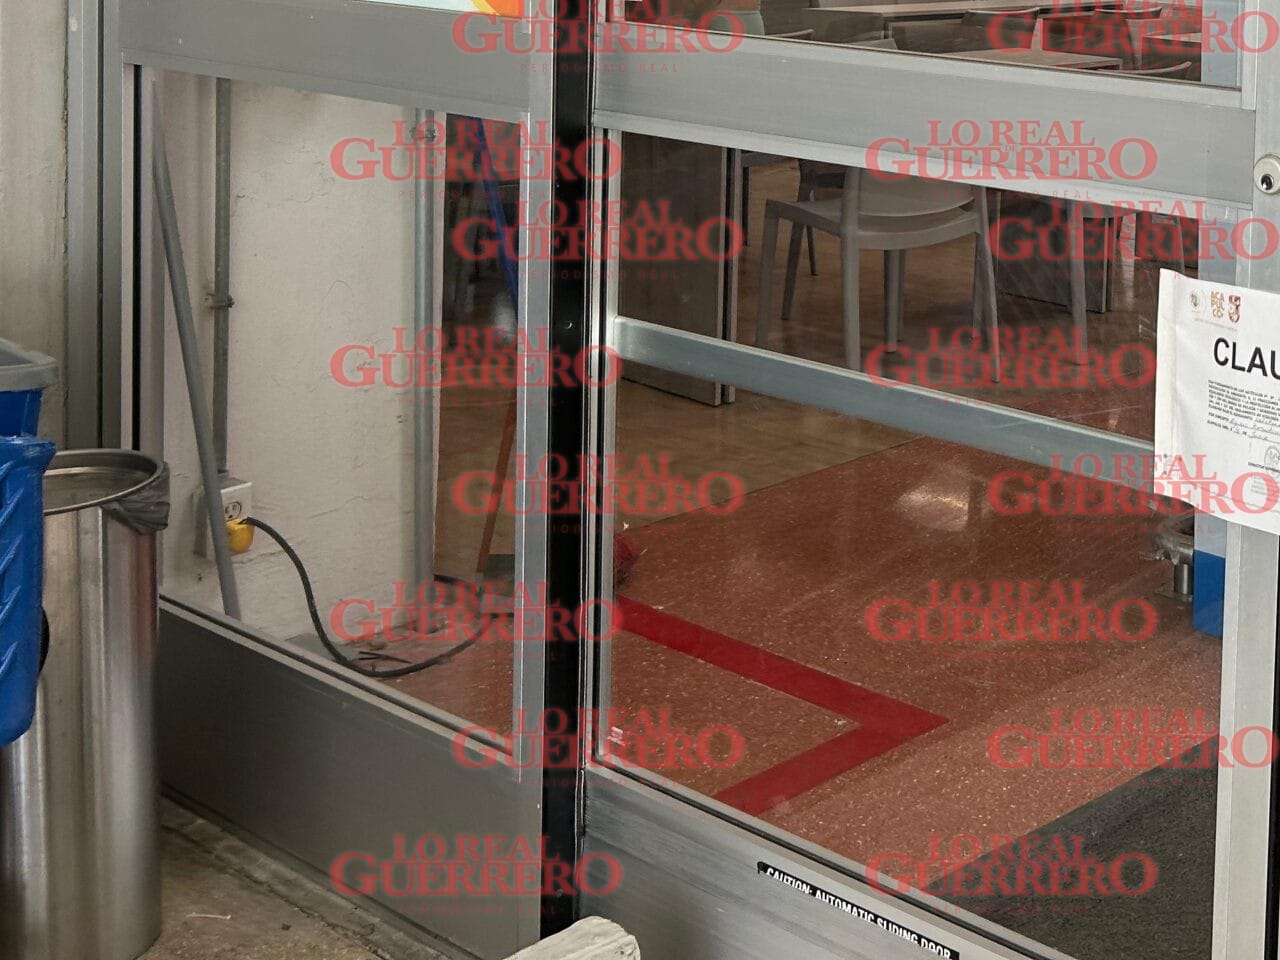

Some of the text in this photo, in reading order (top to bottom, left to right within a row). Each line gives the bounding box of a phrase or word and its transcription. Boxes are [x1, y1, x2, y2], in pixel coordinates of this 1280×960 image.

[815, 890, 875, 924] AUTOMATIC
[876, 918, 918, 944] SLIDING
[921, 938, 950, 959] DOOR
